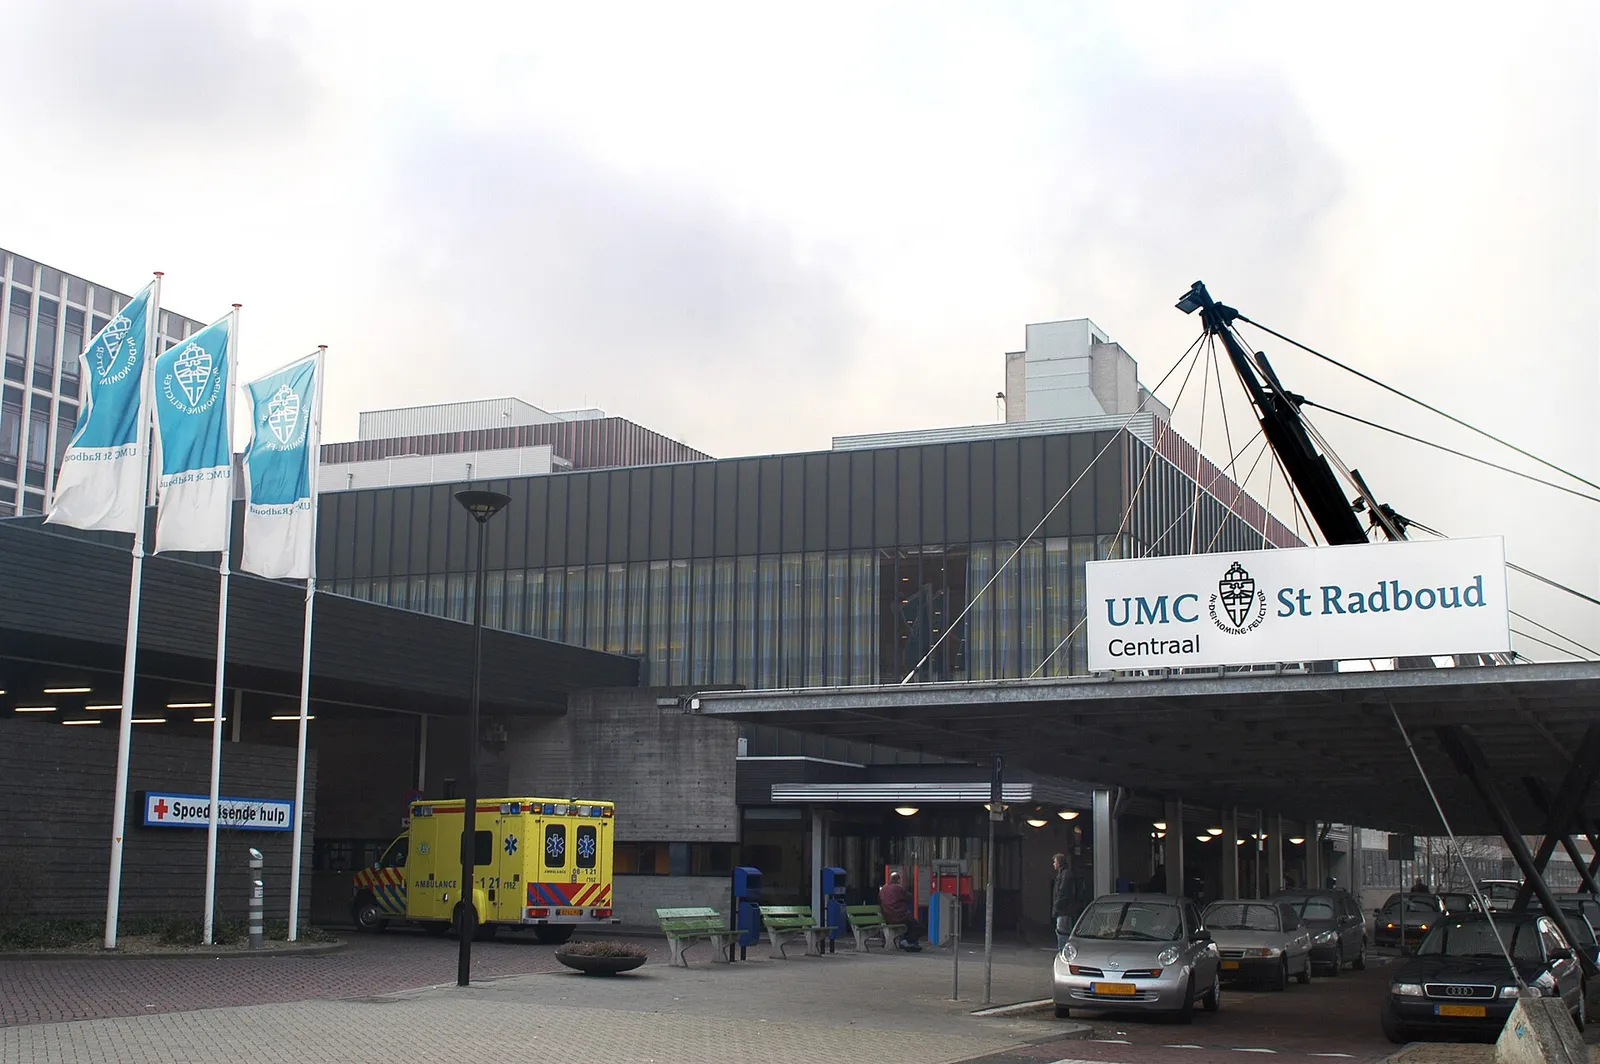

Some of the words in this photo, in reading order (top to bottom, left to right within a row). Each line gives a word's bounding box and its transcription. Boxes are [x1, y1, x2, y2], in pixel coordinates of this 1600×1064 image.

[1104, 592, 1200, 626] UMC
[1277, 587, 1312, 618] St
[1320, 575, 1487, 616] Radboud
[1108, 634, 1200, 657] Centraal
[172, 802, 256, 821] Spoedisende
[260, 806, 285, 824] hulp
[415, 880, 457, 888] AMBULANCE
